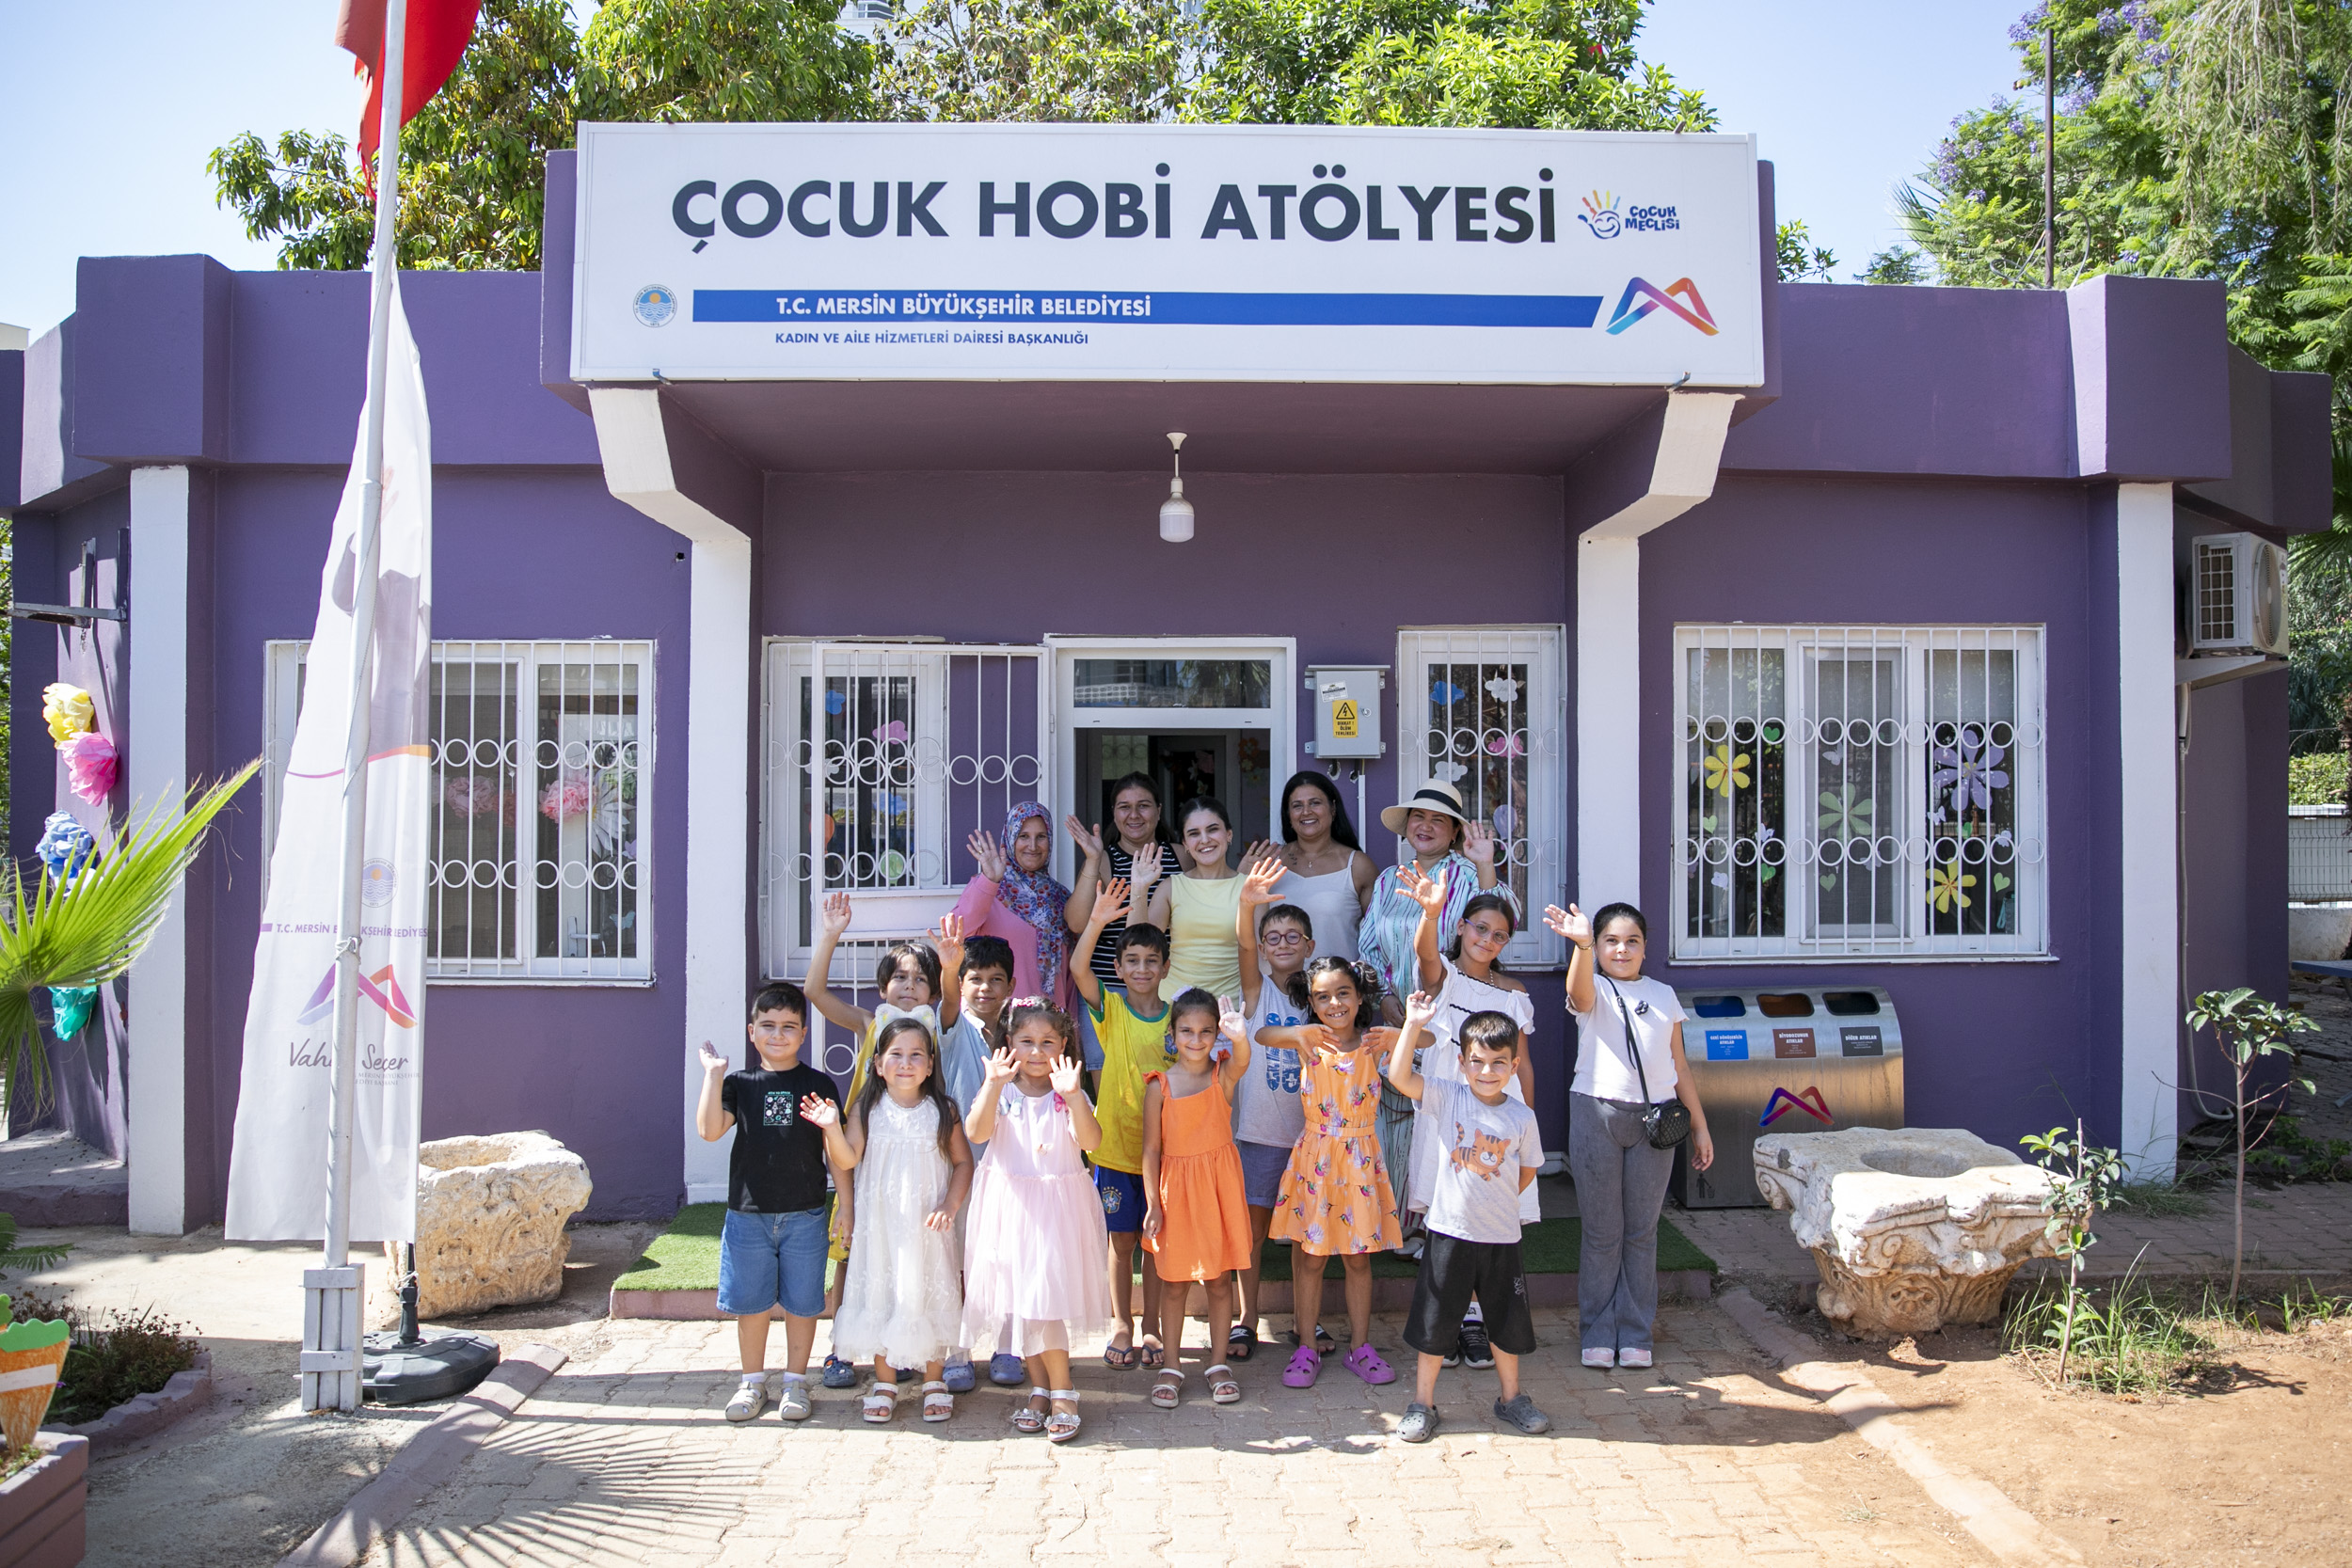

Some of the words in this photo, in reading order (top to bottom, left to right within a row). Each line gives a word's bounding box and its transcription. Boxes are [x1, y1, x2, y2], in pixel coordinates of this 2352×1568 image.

[673, 180, 948, 253] ÇOCUK
[979, 163, 1171, 239] HOBİ
[1201, 164, 1555, 244] ATÖLYESİ
[777, 298, 810, 314] T.C.
[817, 293, 895, 314] MERSİN
[903, 293, 1035, 319] BÜYÜKŞEHİR
[1042, 294, 1151, 317] BELEDİYESİ
[776, 333, 818, 343] KADIN
[823, 333, 840, 343] VE
[844, 330, 869, 343] AİLE
[875, 330, 949, 343] HİZMETLERİ
[954, 330, 1004, 343] DAİRESİ
[1009, 330, 1089, 346] BAŞKANLIĞI
[277, 924, 294, 933] T.C.
[294, 922, 330, 934] MERSİN
